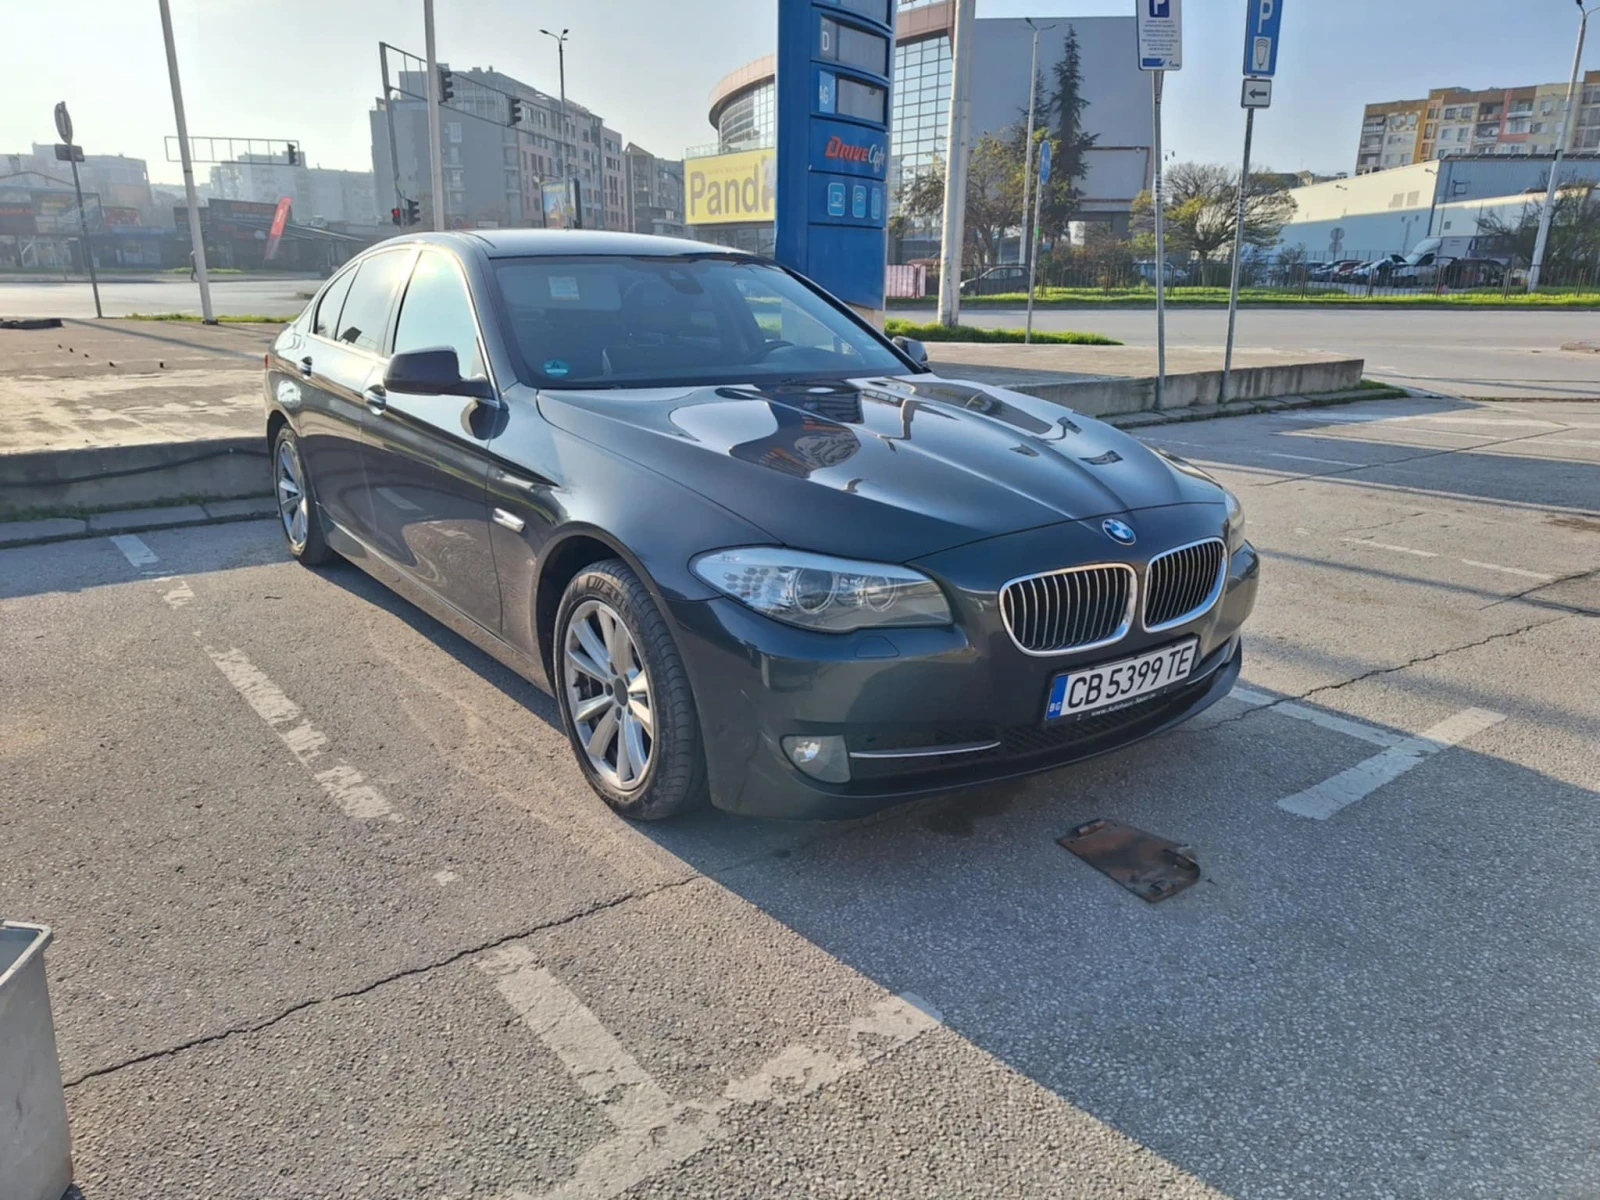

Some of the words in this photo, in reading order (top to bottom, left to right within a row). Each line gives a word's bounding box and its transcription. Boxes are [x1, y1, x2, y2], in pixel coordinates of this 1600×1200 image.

[1257, 0, 1274, 33] P
[821, 32, 830, 51] D
[1105, 656, 1164, 699] 5399
[1049, 701, 1061, 713] BG
